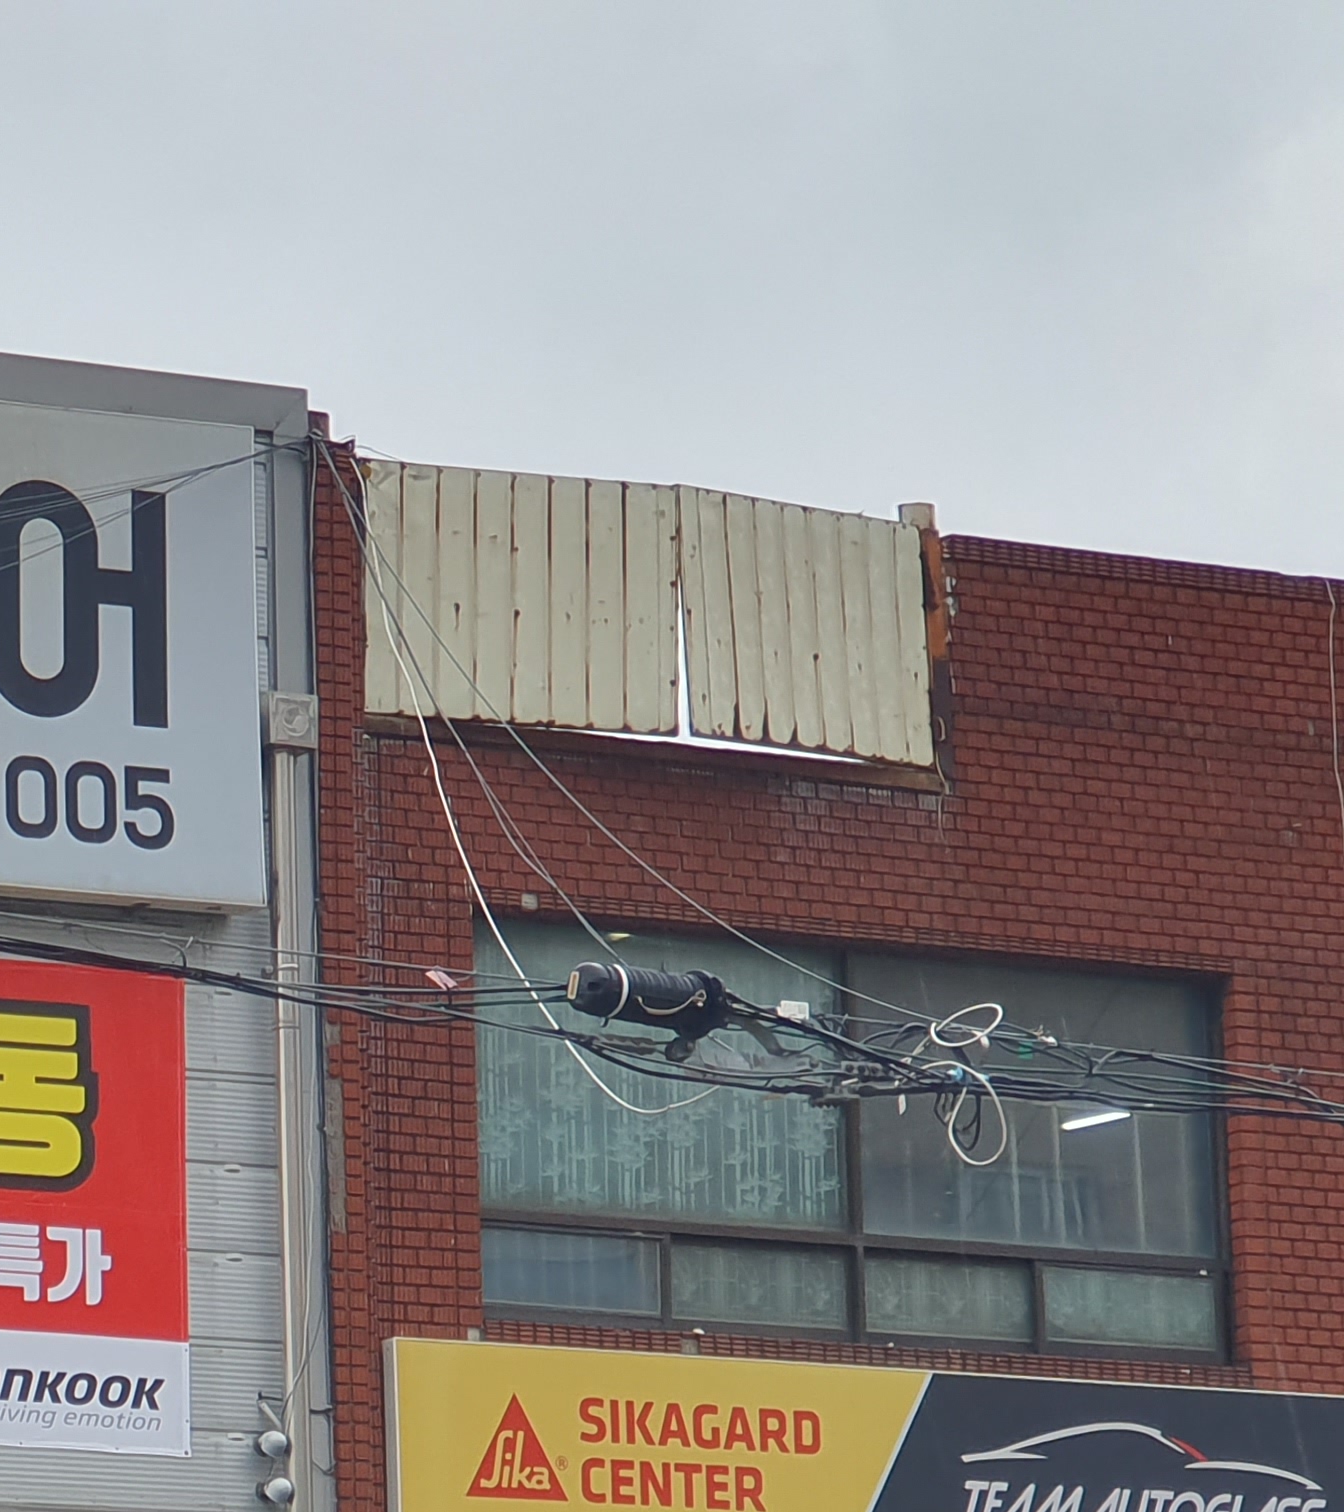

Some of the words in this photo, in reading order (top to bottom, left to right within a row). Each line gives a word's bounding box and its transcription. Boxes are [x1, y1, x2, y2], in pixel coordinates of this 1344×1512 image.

[62, 1408, 162, 1432] emotion
[578, 1397, 822, 1455] SIKAGARD
[580, 1456, 767, 1512] CENTER
